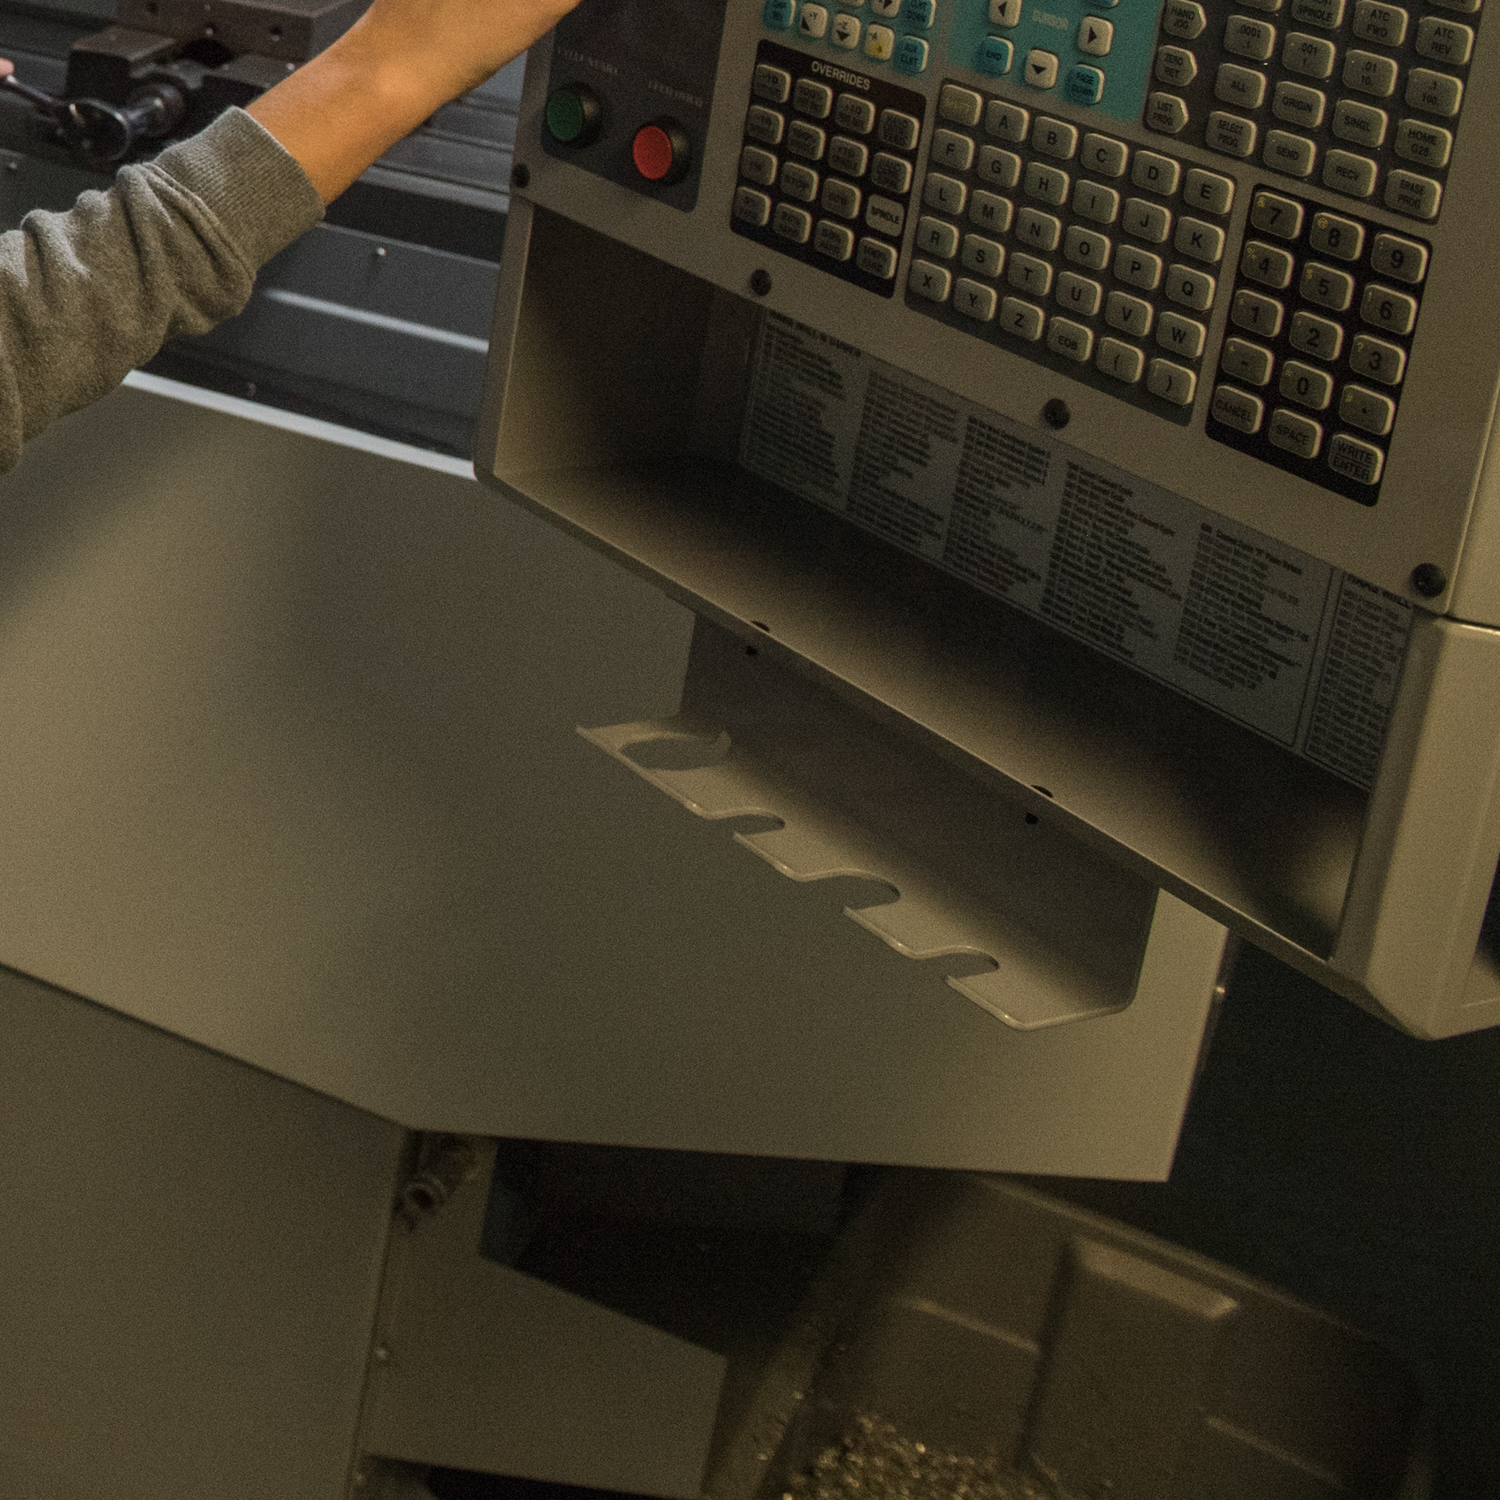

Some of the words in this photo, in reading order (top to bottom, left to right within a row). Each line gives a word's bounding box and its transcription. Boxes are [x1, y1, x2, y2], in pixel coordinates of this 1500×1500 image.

[811, 60, 871, 91] OVERRIDES
[1046, 131, 1057, 146] B
[1096, 149, 1107, 163] C
[1148, 167, 1159, 181] D
[1038, 178, 1049, 192] H
[1200, 184, 1212, 200] E
[1139, 215, 1149, 228] J
[1270, 207, 1283, 226] 7
[1030, 222, 1041, 237] N
[1328, 227, 1341, 247] 8
[1192, 232, 1203, 248] K
[1079, 241, 1090, 256] O
[1130, 261, 1141, 273] P
[1259, 257, 1270, 274] 4
[1390, 249, 1404, 269] 9
[1023, 268, 1033, 281] T
[1071, 286, 1082, 301] U
[1182, 281, 1194, 297] Q
[1318, 278, 1330, 296] 5
[1122, 306, 1133, 322] V
[1251, 306, 1260, 324] 1
[1379, 301, 1392, 320] 6
[1172, 327, 1187, 344] W
[1307, 327, 1321, 347] 2
[1369, 351, 1382, 371] 3
[1296, 376, 1309, 395] 0
[1276, 425, 1309, 446] SPACE
